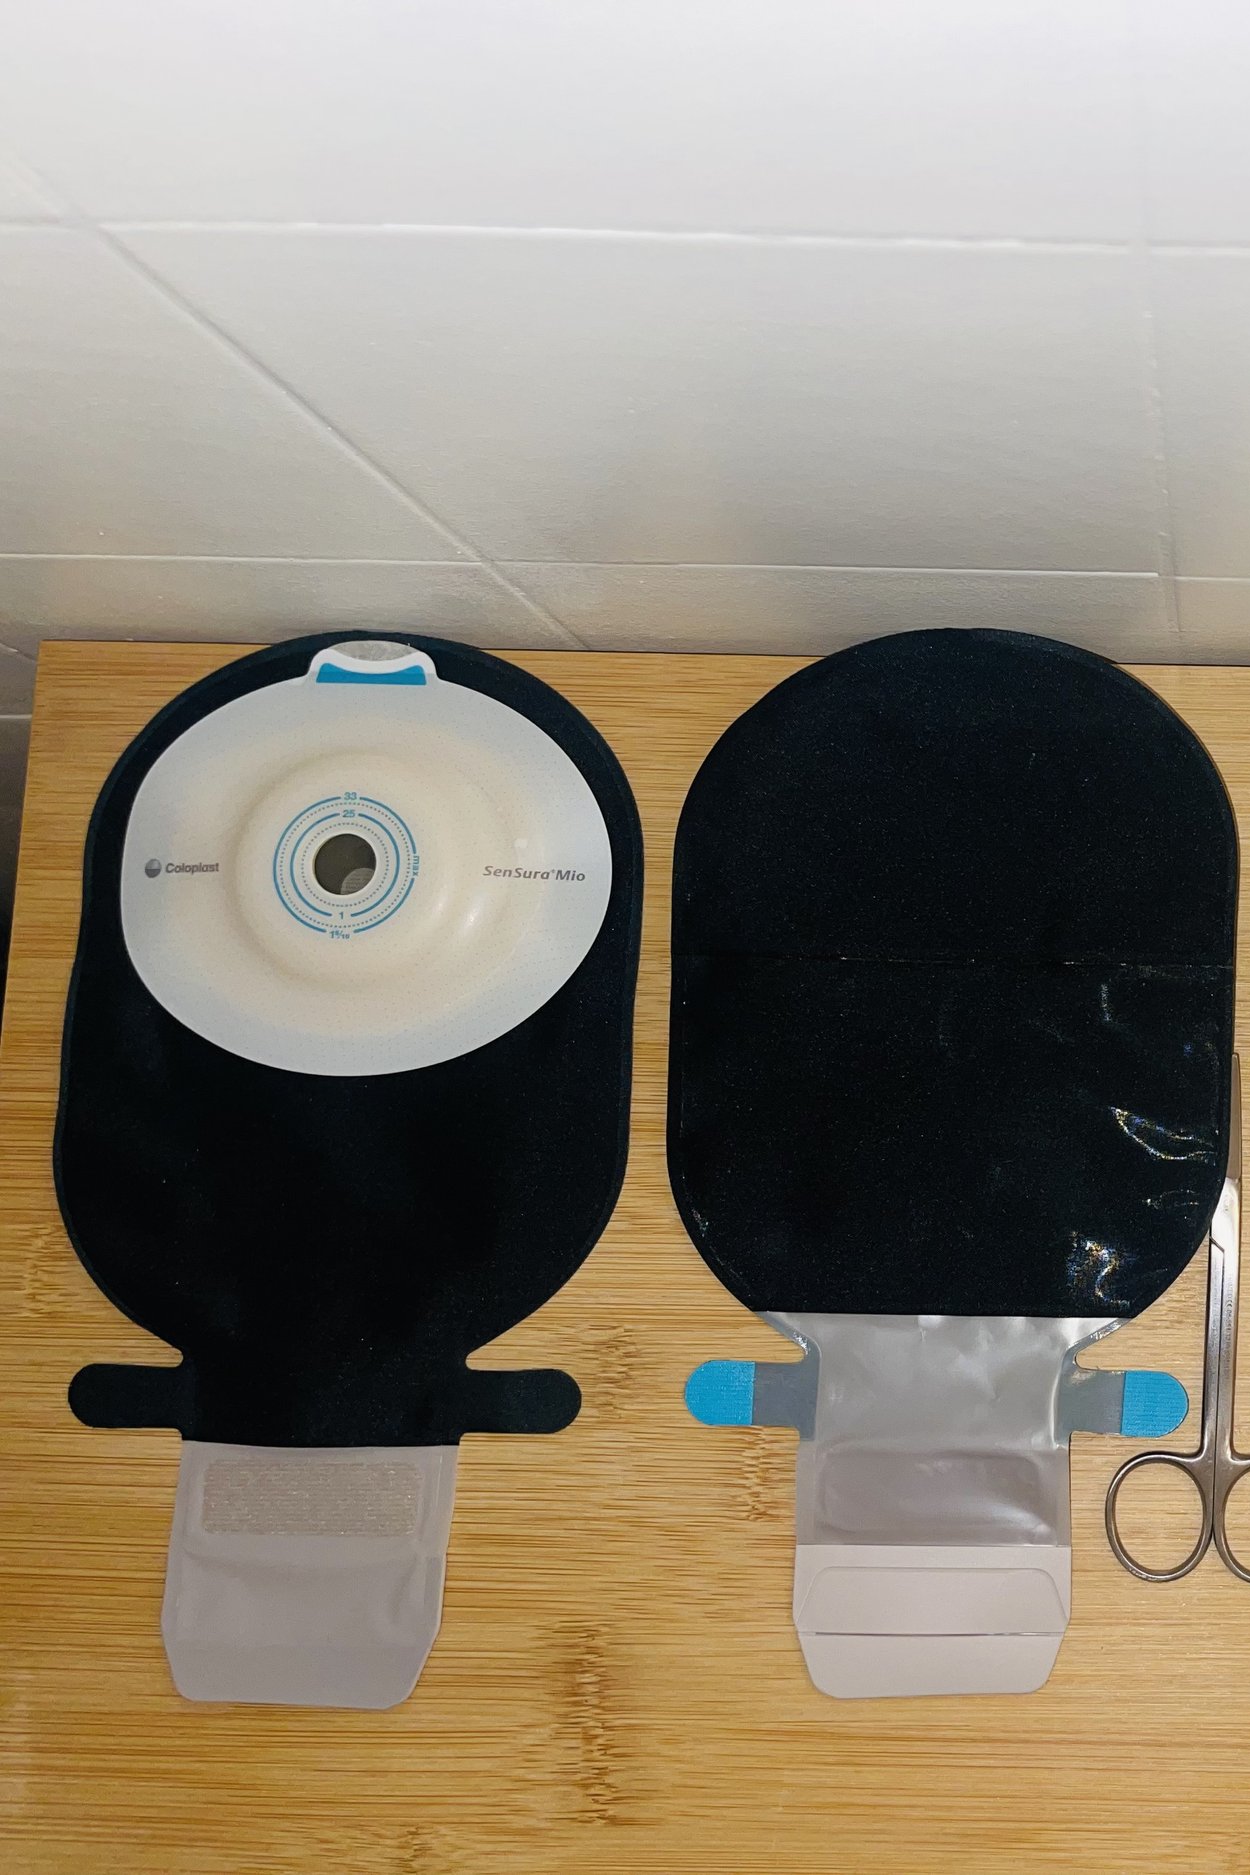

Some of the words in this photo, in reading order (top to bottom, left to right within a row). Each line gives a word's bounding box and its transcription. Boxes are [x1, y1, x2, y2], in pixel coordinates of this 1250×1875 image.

[343, 791, 358, 801] 33
[342, 809, 356, 818] 25
[165, 862, 219, 875] Coloplast
[412, 855, 420, 877] max
[555, 869, 586, 882] Mio
[338, 911, 344, 920] 1
